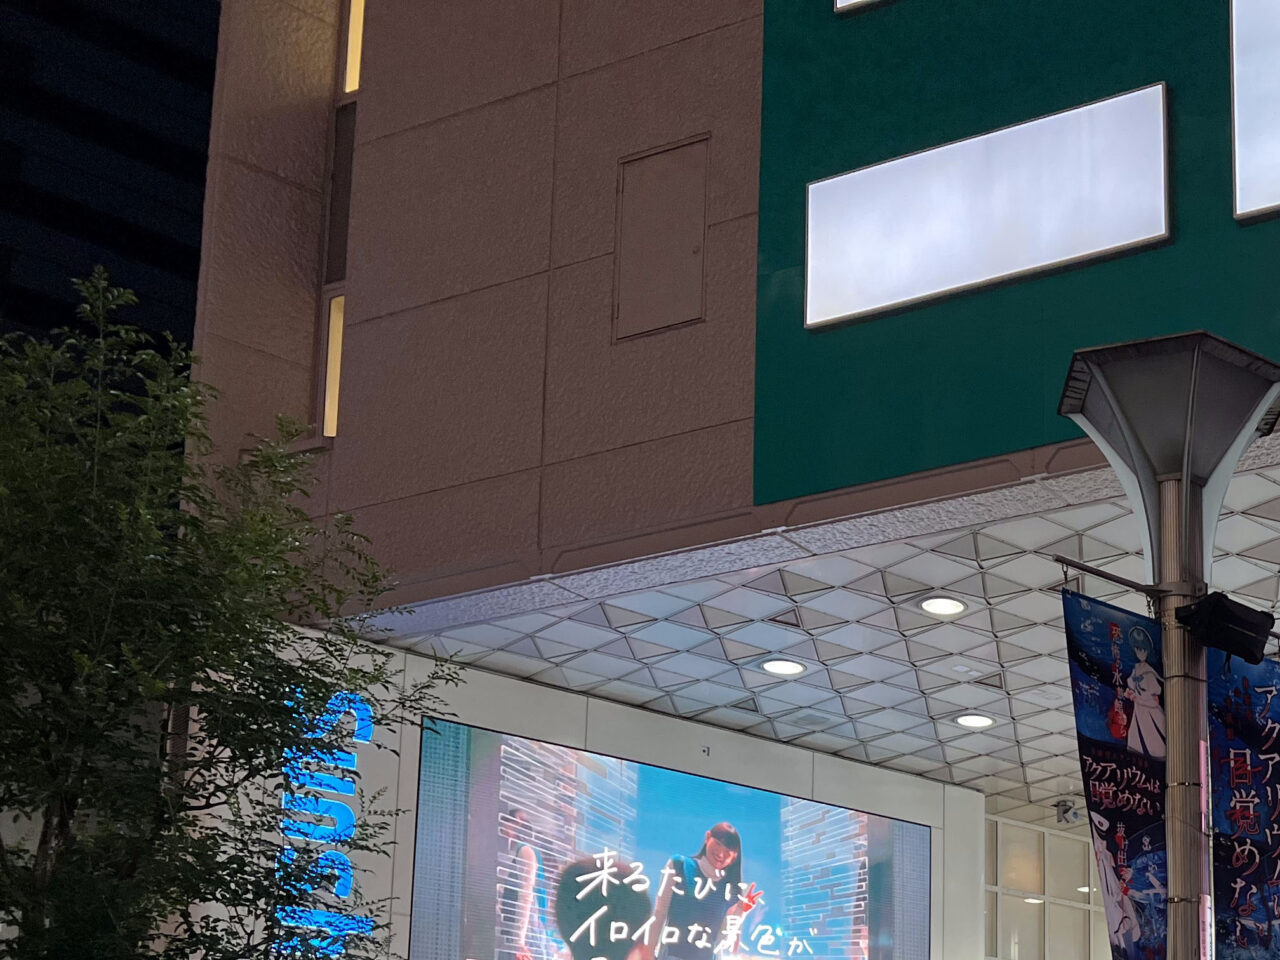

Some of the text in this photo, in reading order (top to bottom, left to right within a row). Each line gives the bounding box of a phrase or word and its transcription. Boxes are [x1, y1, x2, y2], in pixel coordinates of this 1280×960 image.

[1082, 754, 1161, 794] アクアリウムは
[1089, 780, 1161, 816] 目覚めない
[569, 905, 818, 958] イロイロな景色が
